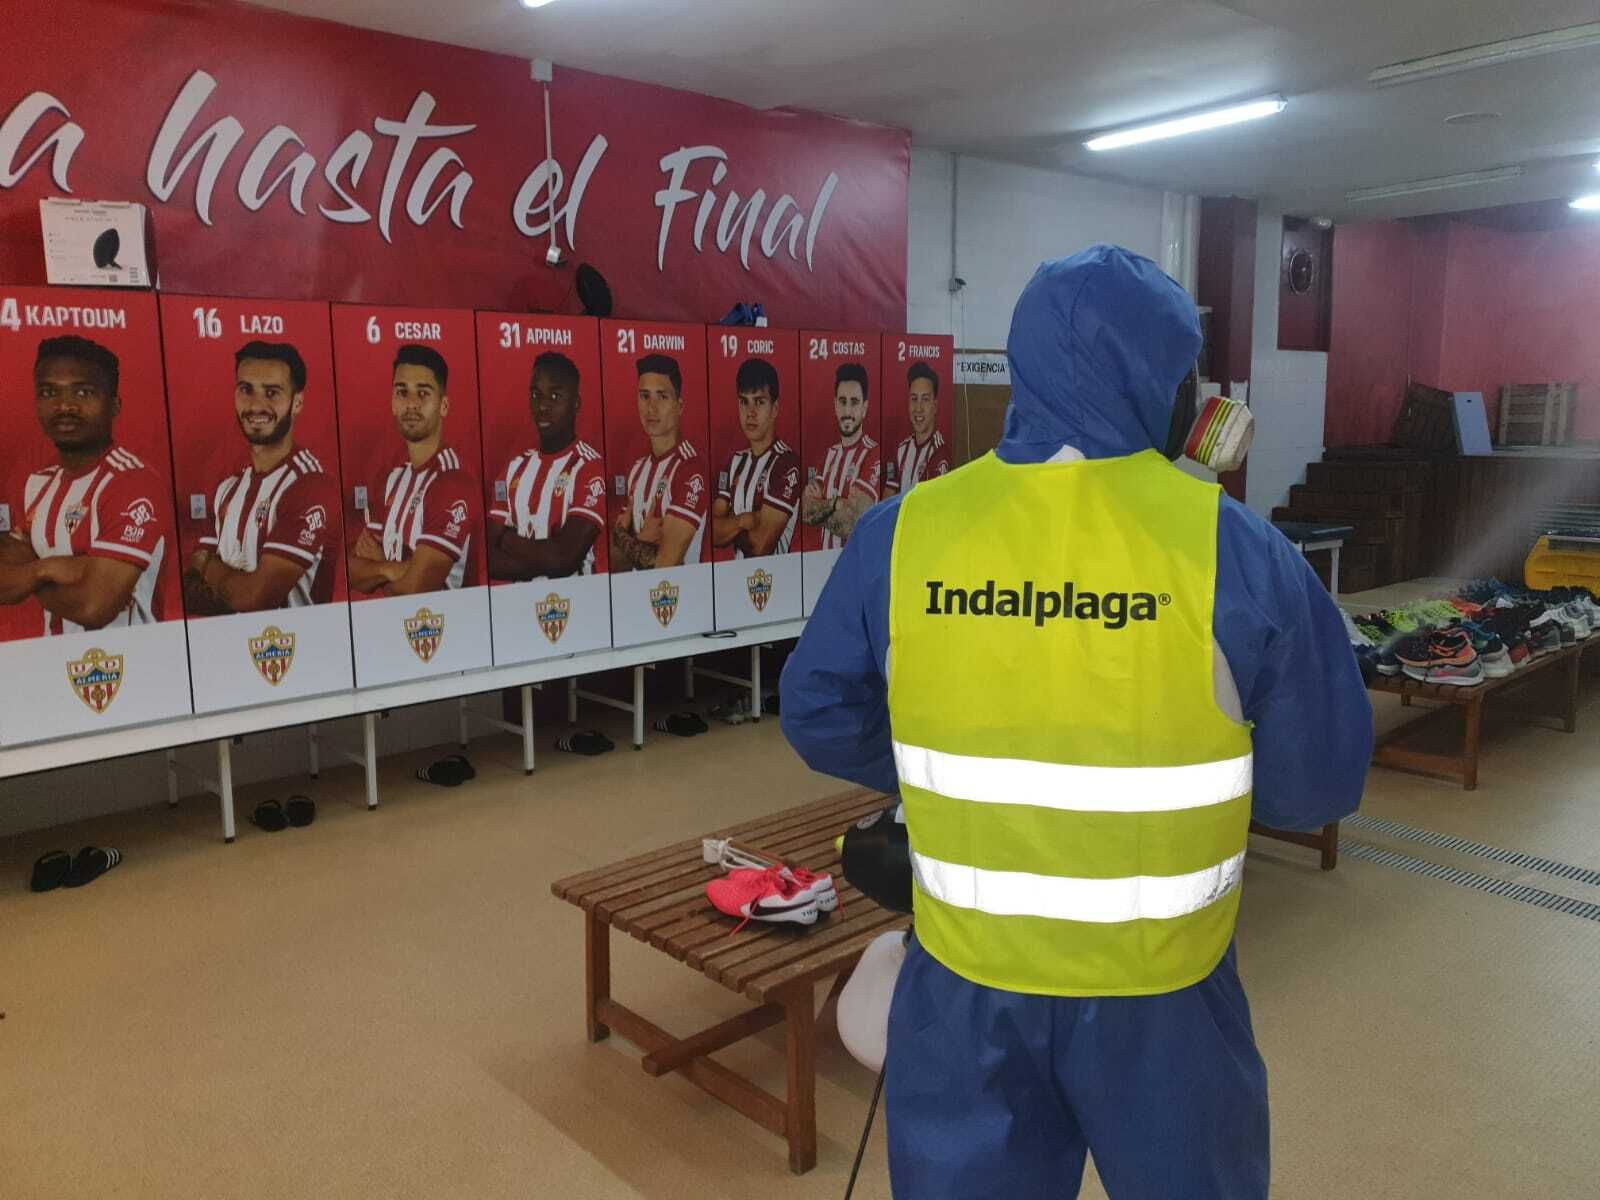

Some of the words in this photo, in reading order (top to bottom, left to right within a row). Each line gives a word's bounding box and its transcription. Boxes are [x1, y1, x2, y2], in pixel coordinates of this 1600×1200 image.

[146, 69, 477, 244] hasta
[513, 133, 609, 251] el
[654, 145, 840, 273] Final
[25, 305, 126, 329] KAPTOUM
[192, 307, 223, 338] 16
[240, 314, 284, 335] LAZO
[366, 316, 381, 344] 6
[394, 321, 441, 341] CESAR
[499, 322, 521, 349] 31
[526, 327, 572, 345] APPIAH
[617, 329, 636, 353] 21
[643, 334, 685, 351] DARWIN
[720, 335, 738, 357] 19
[747, 339, 774, 354] CORIC
[809, 338, 829, 361] 24
[833, 341, 865, 355] COSTAS
[898, 341, 906, 361] 2
[909, 344, 940, 359] FRANCIS
